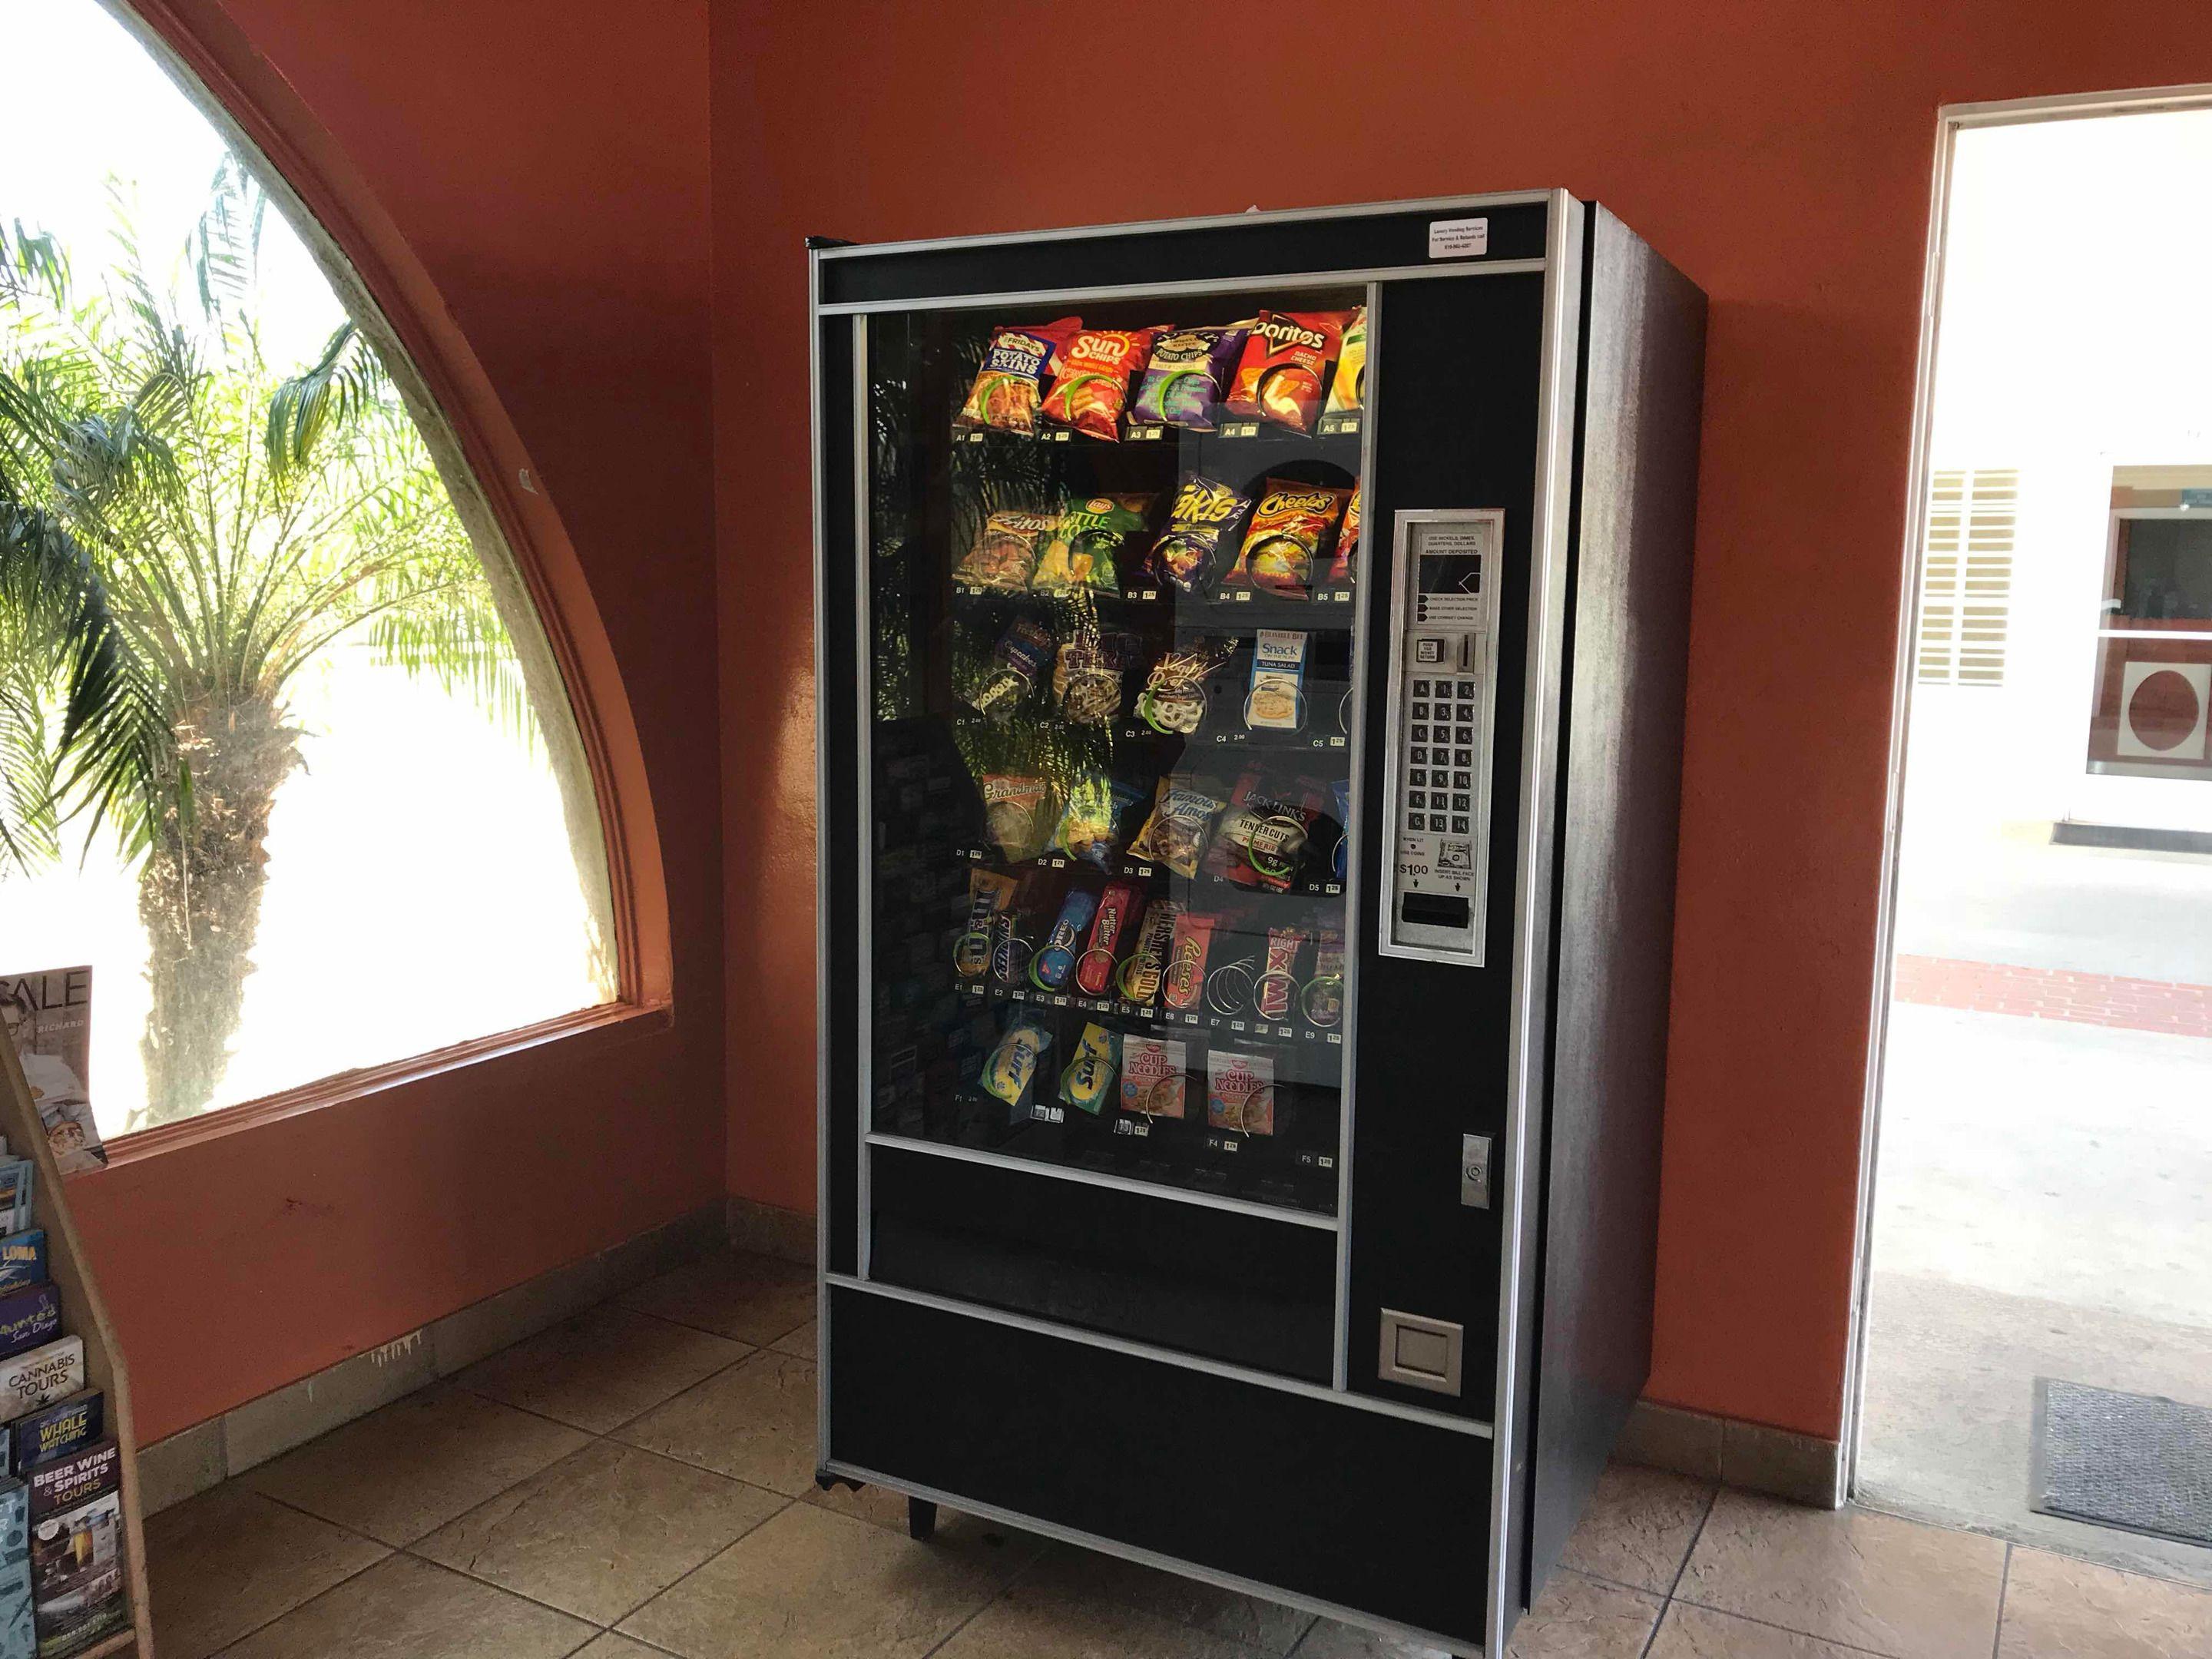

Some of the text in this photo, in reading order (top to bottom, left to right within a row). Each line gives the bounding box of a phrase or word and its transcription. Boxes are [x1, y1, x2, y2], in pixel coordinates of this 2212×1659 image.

[1251, 322, 1325, 349] Doritos
[1071, 335, 1124, 359] Sun
[1155, 348, 1204, 361] POTATO CHIPS
[1294, 350, 1317, 361] NACHO
[992, 349, 1041, 366] POTATO
[1088, 351, 1121, 366] CHIPS
[1290, 355, 1316, 366] CHEESE
[989, 359, 1038, 375] SKINS
[1258, 492, 1336, 517] Cheetos
[1005, 640, 1037, 667] Cupcakes
[1262, 643, 1297, 656] Snack
[1243, 791, 1270, 810] JACK
[1269, 828, 1290, 843] CUTS
[1399, 863, 1429, 876] $1.00
[1054, 919, 1069, 951] OREO
[1101, 919, 1110, 946] Butter
[1270, 936, 1300, 953] RIGHT
[37, 1019, 84, 1035] RICHARD
[1140, 1052, 1167, 1066] CUP
[1128, 1061, 1177, 1077] NOODLES
[1226, 1068, 1254, 1082] CUP
[1216, 1078, 1265, 1094] NOODLES
[8, 1353, 75, 1387] CANNABIS
[16, 1369, 69, 1399] TOURS
[40, 1410, 88, 1442] WHALE
[33, 1447, 116, 1488] BEER WINE
[43, 1462, 109, 1497] & SPIRITS
[53, 1479, 101, 1505] TOURS
